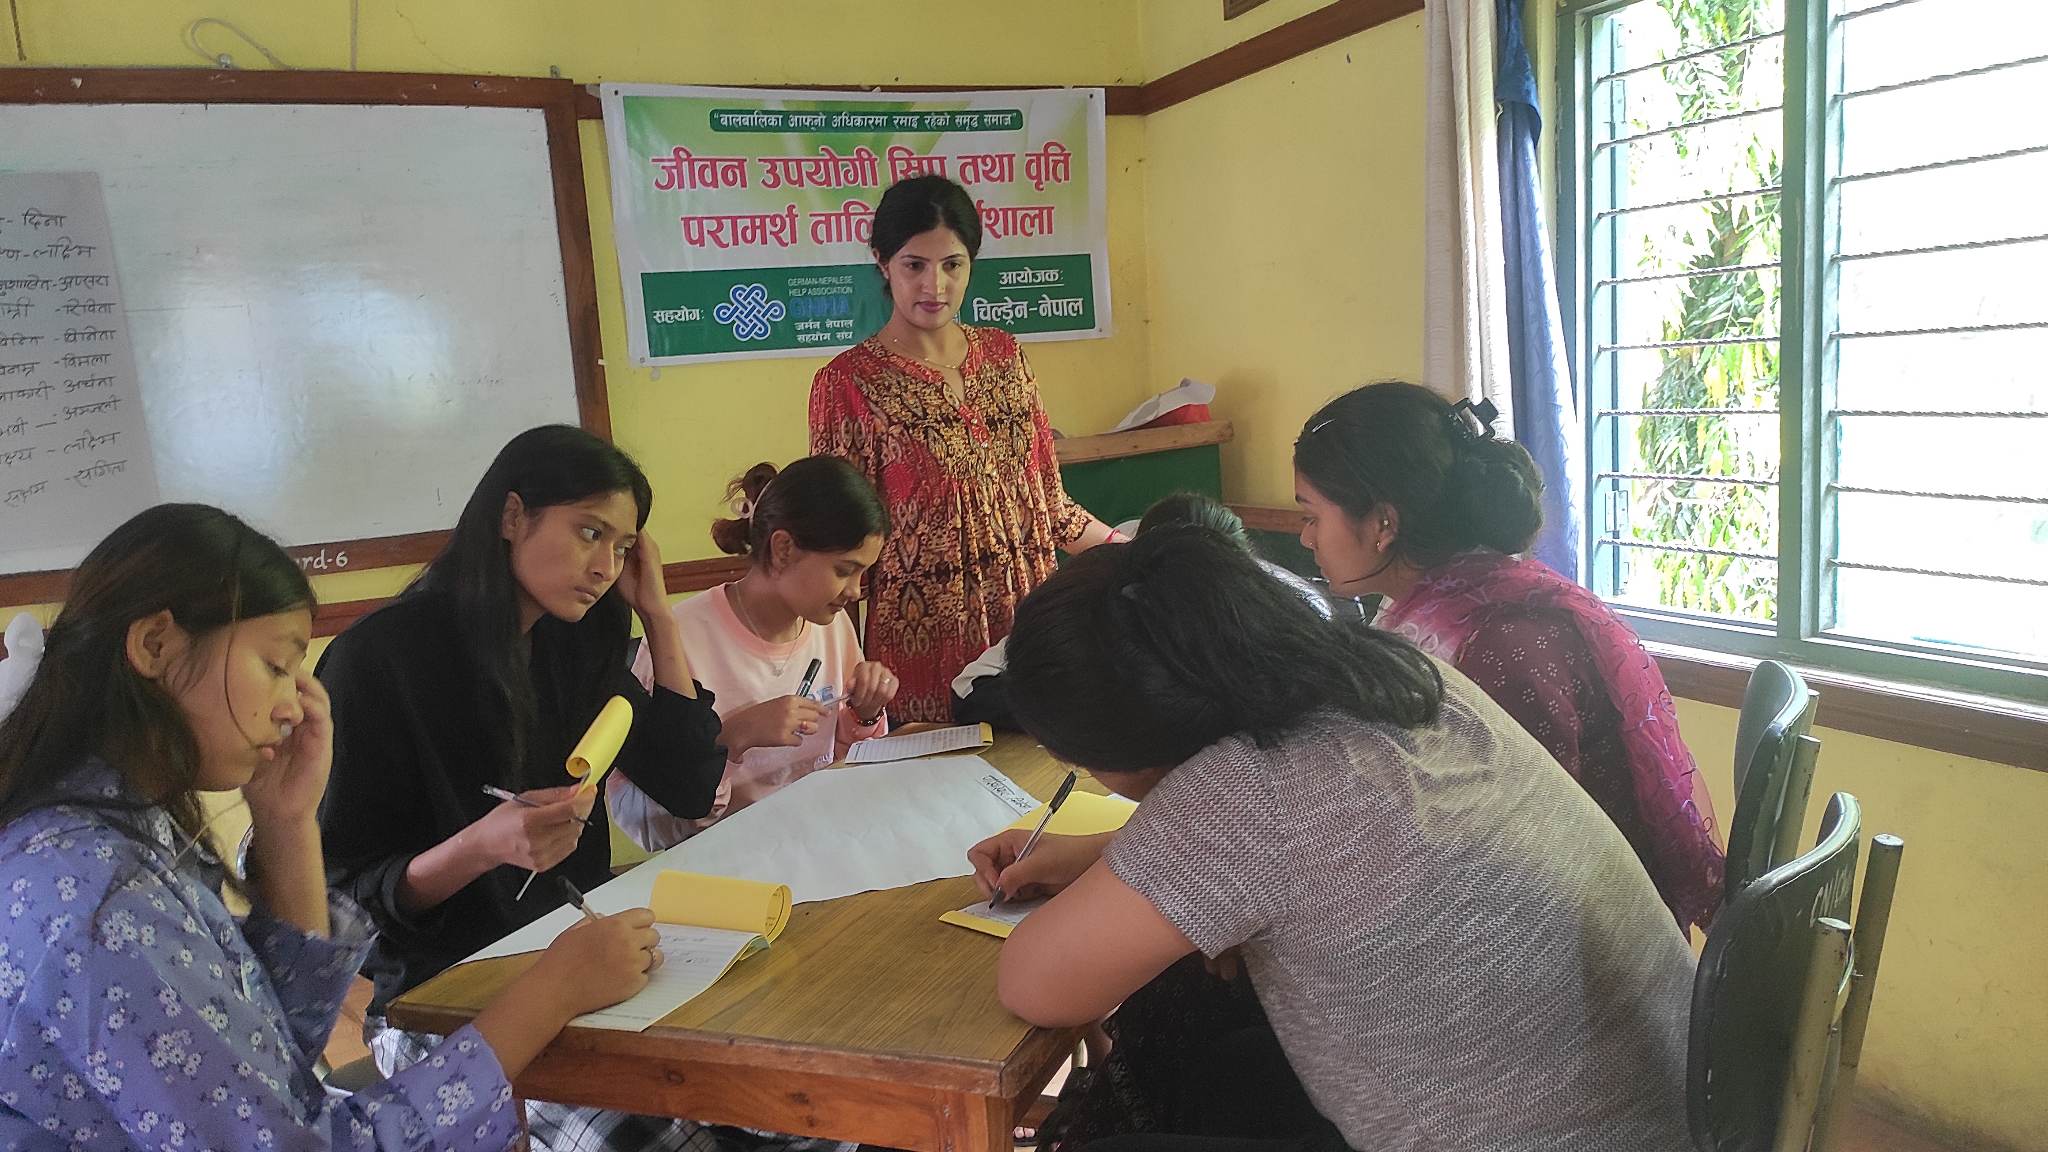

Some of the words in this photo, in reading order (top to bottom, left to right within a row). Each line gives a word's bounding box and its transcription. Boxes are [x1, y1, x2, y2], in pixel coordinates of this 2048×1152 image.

[832, 111, 888, 129] अधिकारमा
[892, 114, 920, 128] रमाइ
[924, 112, 951, 129] रहेको
[651, 146, 748, 191] जीवन
[758, 146, 880, 189] उपयोगी
[957, 152, 1016, 186] तथा
[1024, 141, 1072, 191] वृत्ति
[680, 203, 798, 249] परामर्श
[808, 200, 877, 244] तालि
[788, 275, 854, 287] GERMAN-NEPALESE
[788, 288, 807, 297] HELP
[808, 286, 854, 296] ASSOCIATION
[298, 549, 349, 571] rd-6
